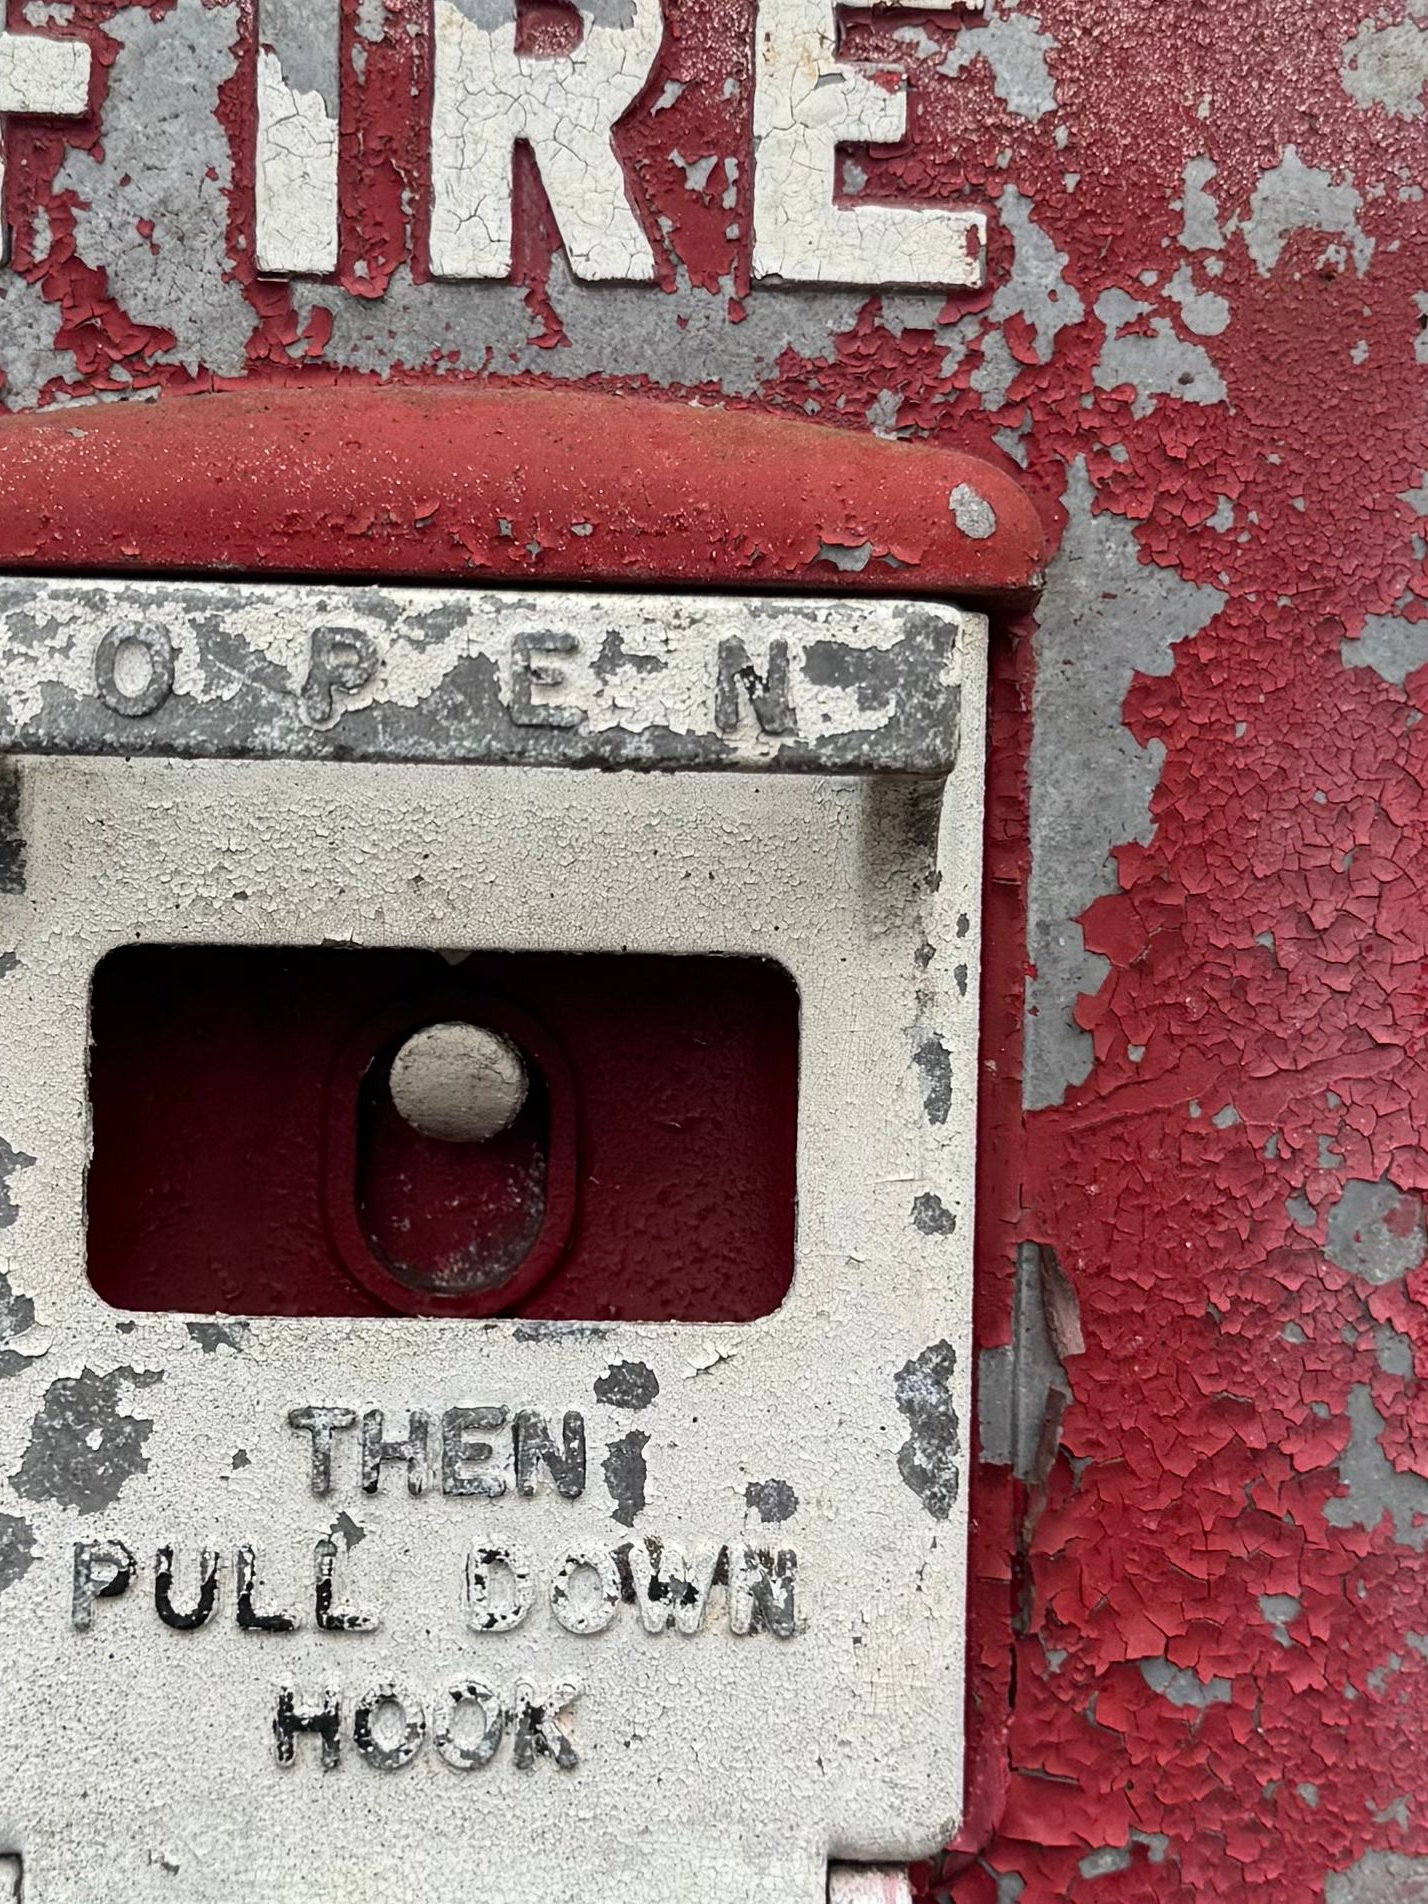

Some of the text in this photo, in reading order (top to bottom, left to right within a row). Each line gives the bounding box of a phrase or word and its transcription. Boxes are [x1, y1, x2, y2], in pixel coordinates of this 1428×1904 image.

[93, 620, 798, 739] OPEN
[287, 1404, 588, 1498] THEN
[71, 1536, 800, 1640] PULL DOWN
[273, 1679, 582, 1772] HOOK
